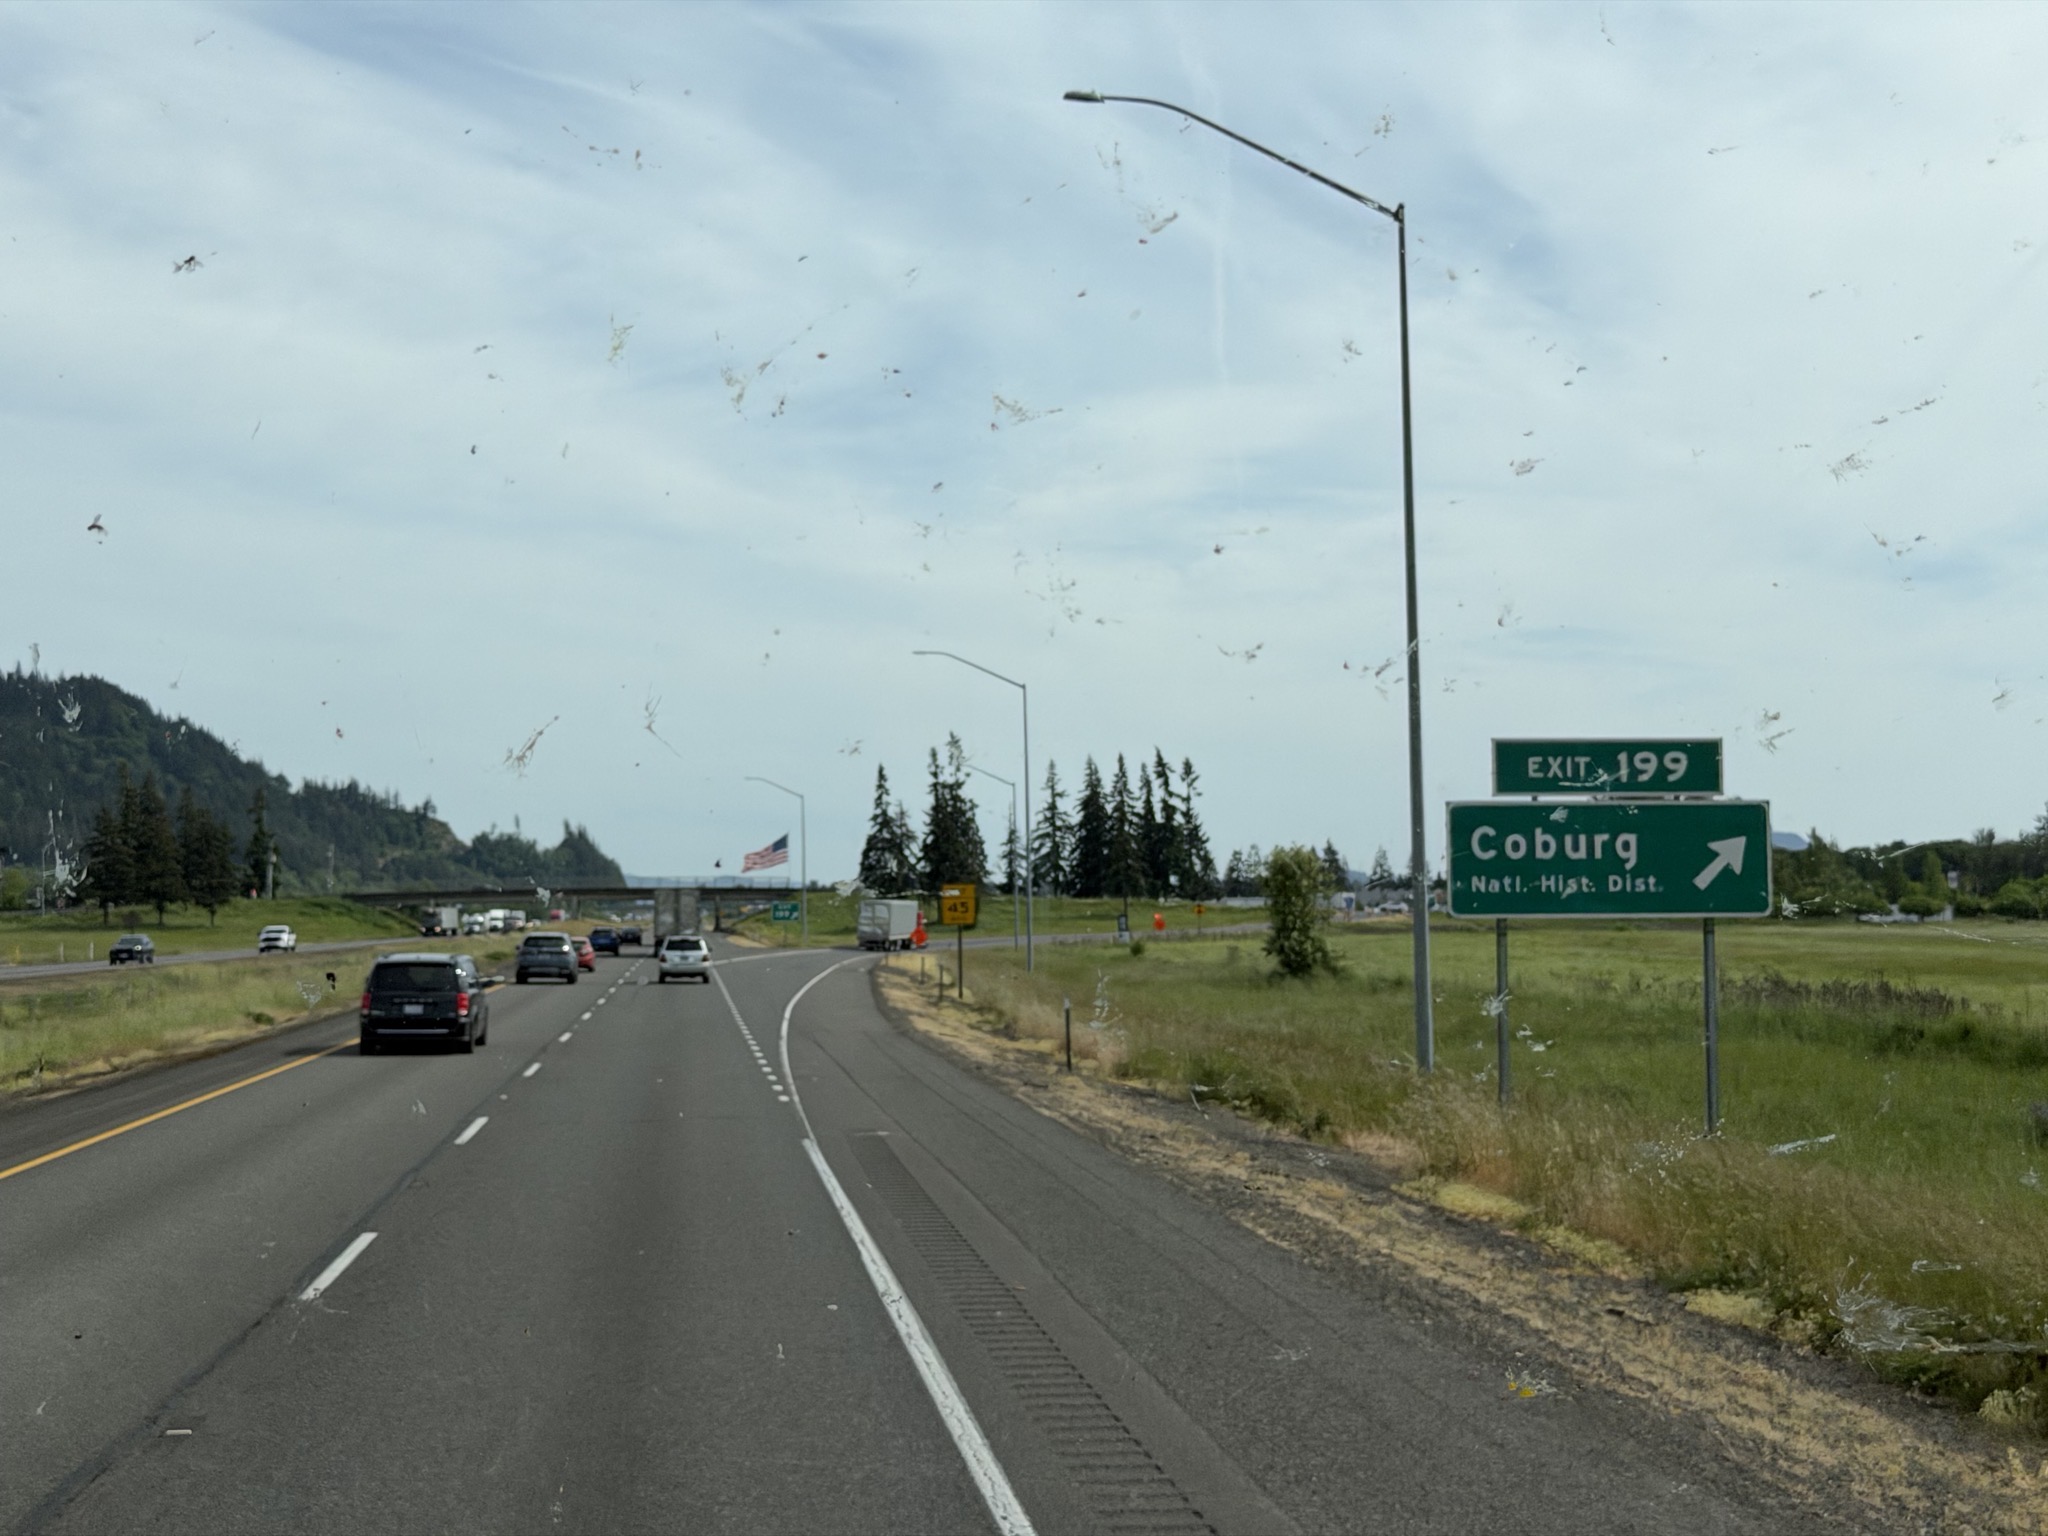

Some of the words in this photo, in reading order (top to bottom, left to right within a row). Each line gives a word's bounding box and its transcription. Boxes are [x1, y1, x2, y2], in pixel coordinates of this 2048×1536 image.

[1528, 755, 1591, 780] EXIT
[1616, 750, 1688, 782] 199
[1471, 825, 1637, 871] Coburg
[1471, 875, 1527, 892] Natl.
[1608, 874, 1663, 892] Dist.
[947, 901, 969, 914] 45
